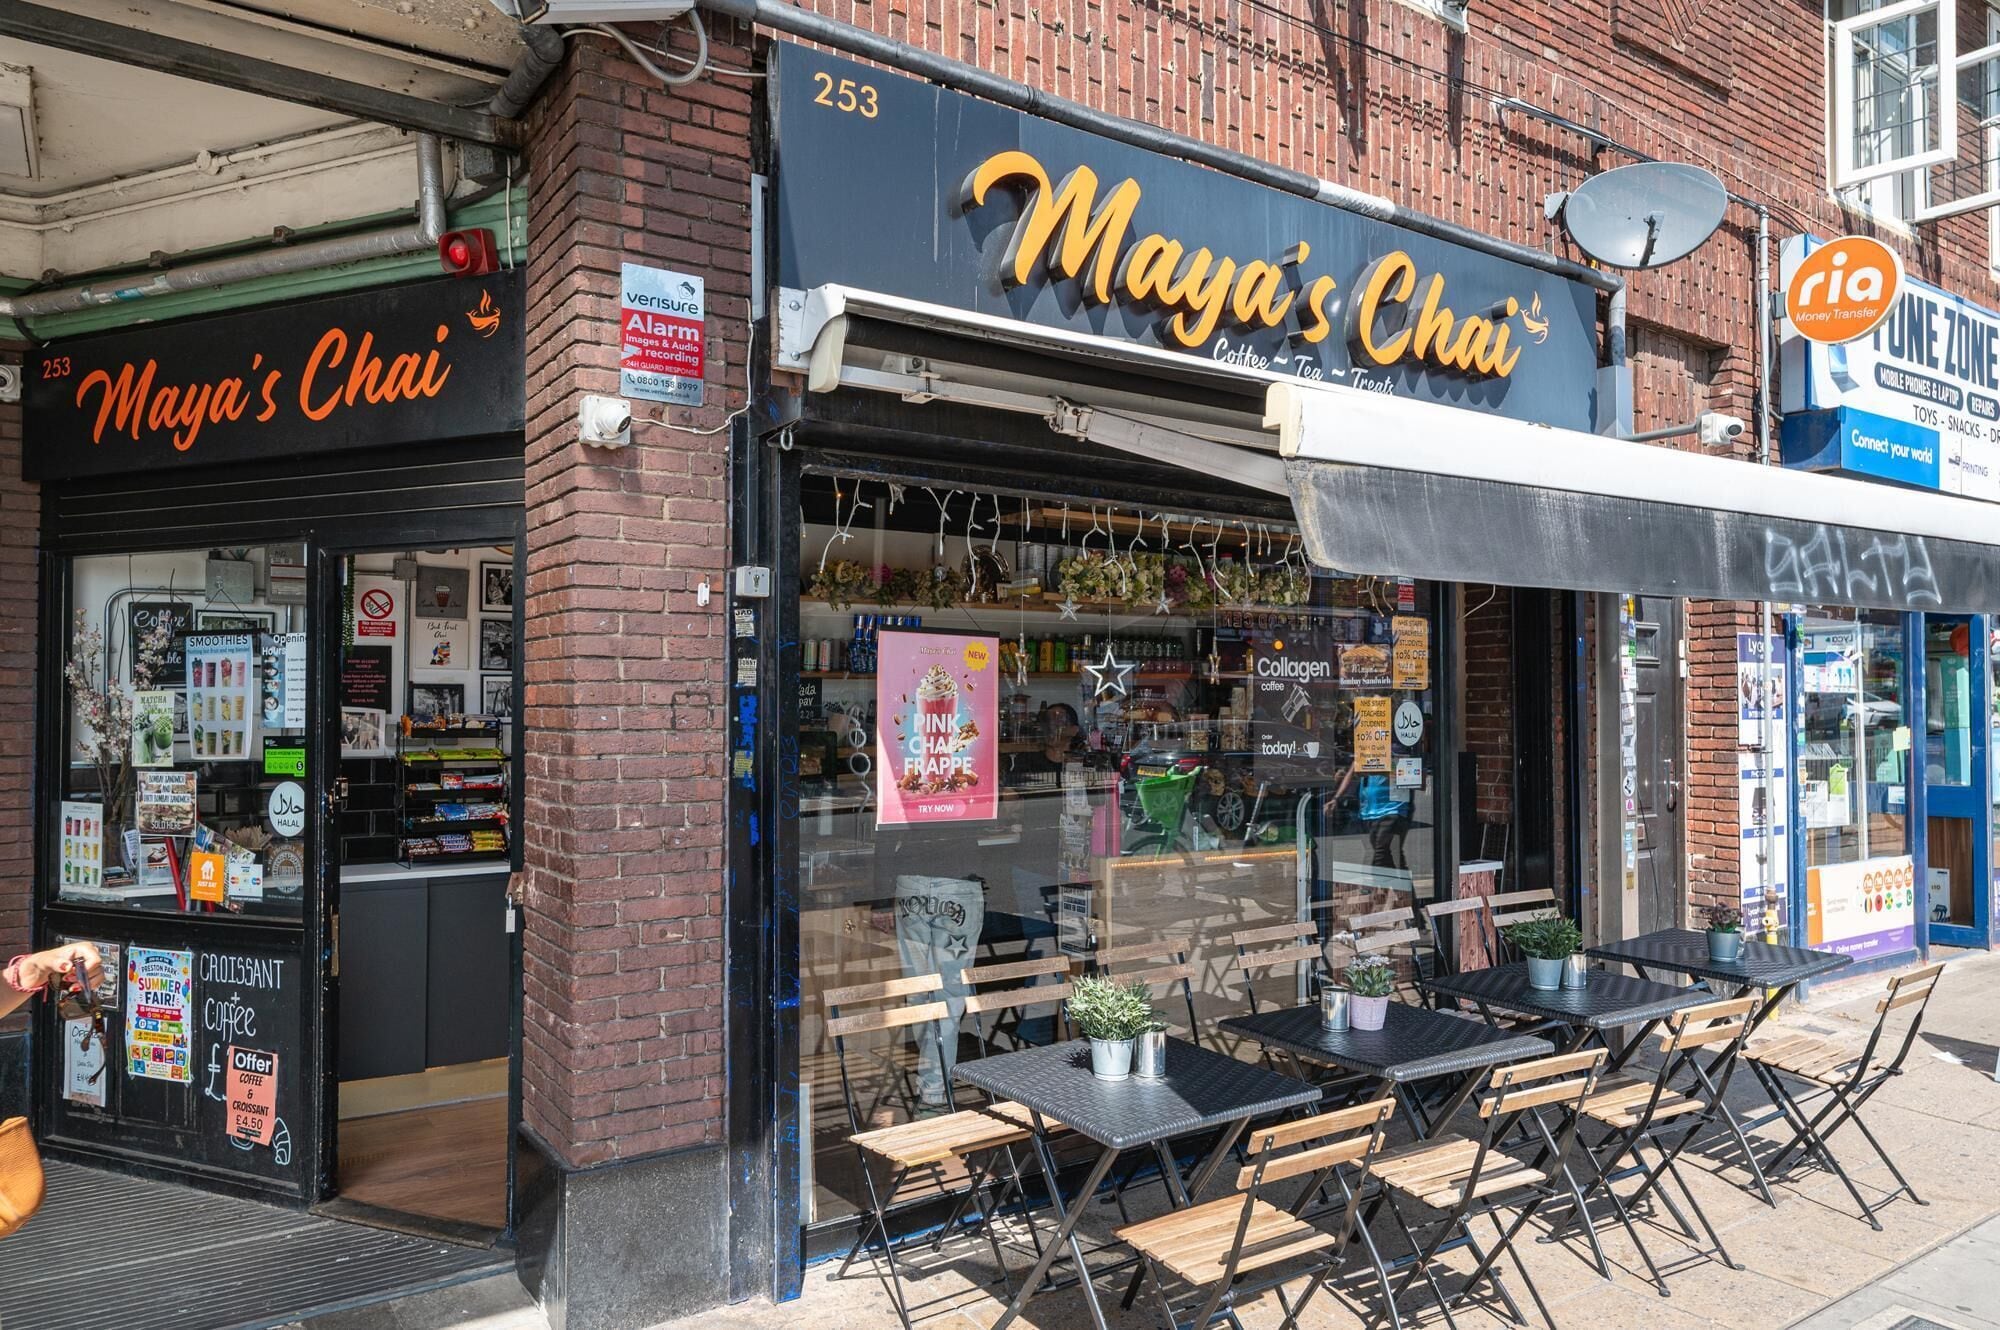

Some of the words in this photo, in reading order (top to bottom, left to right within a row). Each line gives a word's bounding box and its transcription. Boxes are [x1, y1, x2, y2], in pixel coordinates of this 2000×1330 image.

[814, 72, 880, 119] 253
[970, 150, 1337, 347] Maya's
[1357, 252, 1522, 380] Chai
[1798, 251, 1884, 307] ria
[627, 292, 699, 314] verisure
[1796, 311, 1832, 323] Money
[1834, 307, 1878, 319] Transfer
[626, 313, 699, 342] Alarm
[626, 333, 659, 347] Images
[662, 339, 669, 348] &
[672, 342, 699, 353] Audio
[1944, 306, 1999, 391] ZONE
[645, 348, 699, 367] recording
[43, 357, 71, 379] 253
[640, 361, 665, 372] GUARD
[665, 364, 699, 377] RESPONSE
[1213, 337, 1271, 370] Coffee
[1294, 354, 1324, 381] Tea
[1351, 367, 1395, 396] Treats
[76, 353, 283, 451] Maya's
[299, 324, 452, 421] Chai
[637, 376, 659, 387] 0800
[677, 382, 698, 392] 8999
[1880, 366, 1905, 389] MOBILE
[1905, 374, 1931, 397] PHONES
[1938, 384, 1960, 406] LAPTOP
[1913, 404, 1938, 426] TOYS
[1948, 415, 1981, 438] SNACKS
[1852, 429, 1889, 454] Connect
[1890, 441, 1911, 459] your
[1911, 447, 1933, 465] world
[1962, 461, 1989, 477] PRINTING
[189, 634, 248, 647] SMOOTHIES
[273, 633, 306, 645] Openin
[262, 646, 287, 657] Hours
[968, 650, 986, 661] NEW
[1412, 650, 1427, 660] OFF
[1257, 656, 1330, 683] Collagen
[1261, 680, 1285, 691] coffee
[1362, 675, 1391, 685] Sandwich
[1360, 699, 1372, 707] NHS
[1360, 709, 1386, 717] TEACHERS
[913, 713, 961, 734] PINK
[1360, 720, 1387, 728] STUDENTS
[1357, 730, 1373, 741] 10%
[1374, 730, 1390, 741] OFF
[908, 735, 958, 755] CHAI
[1262, 740, 1297, 758] today!
[904, 757, 973, 776] FRAPPE
[273, 793, 305, 816] حلال
[918, 805, 933, 814] TRY
[934, 804, 955, 813] NOW
[151, 820, 164, 830] SOLD
[165, 821, 181, 830] HERE
[277, 818, 300, 828] HALAL
[1835, 945, 1849, 954] Online
[1849, 943, 1863, 952] money
[1863, 939, 1879, 948] transfer
[142, 964, 163, 973] PRESTON
[164, 966, 177, 976] PARK
[200, 953, 284, 989] CROISSANT
[138, 977, 181, 994] SUMMER
[145, 992, 175, 1007] FAIR!
[204, 998, 256, 1042] Coffee
[235, 1052, 272, 1073] Offer
[239, 1073, 263, 1087] COFFEE
[247, 1089, 253, 1099] &
[232, 1100, 269, 1117] CROISSANT
[236, 1114, 263, 1130] £4.50
